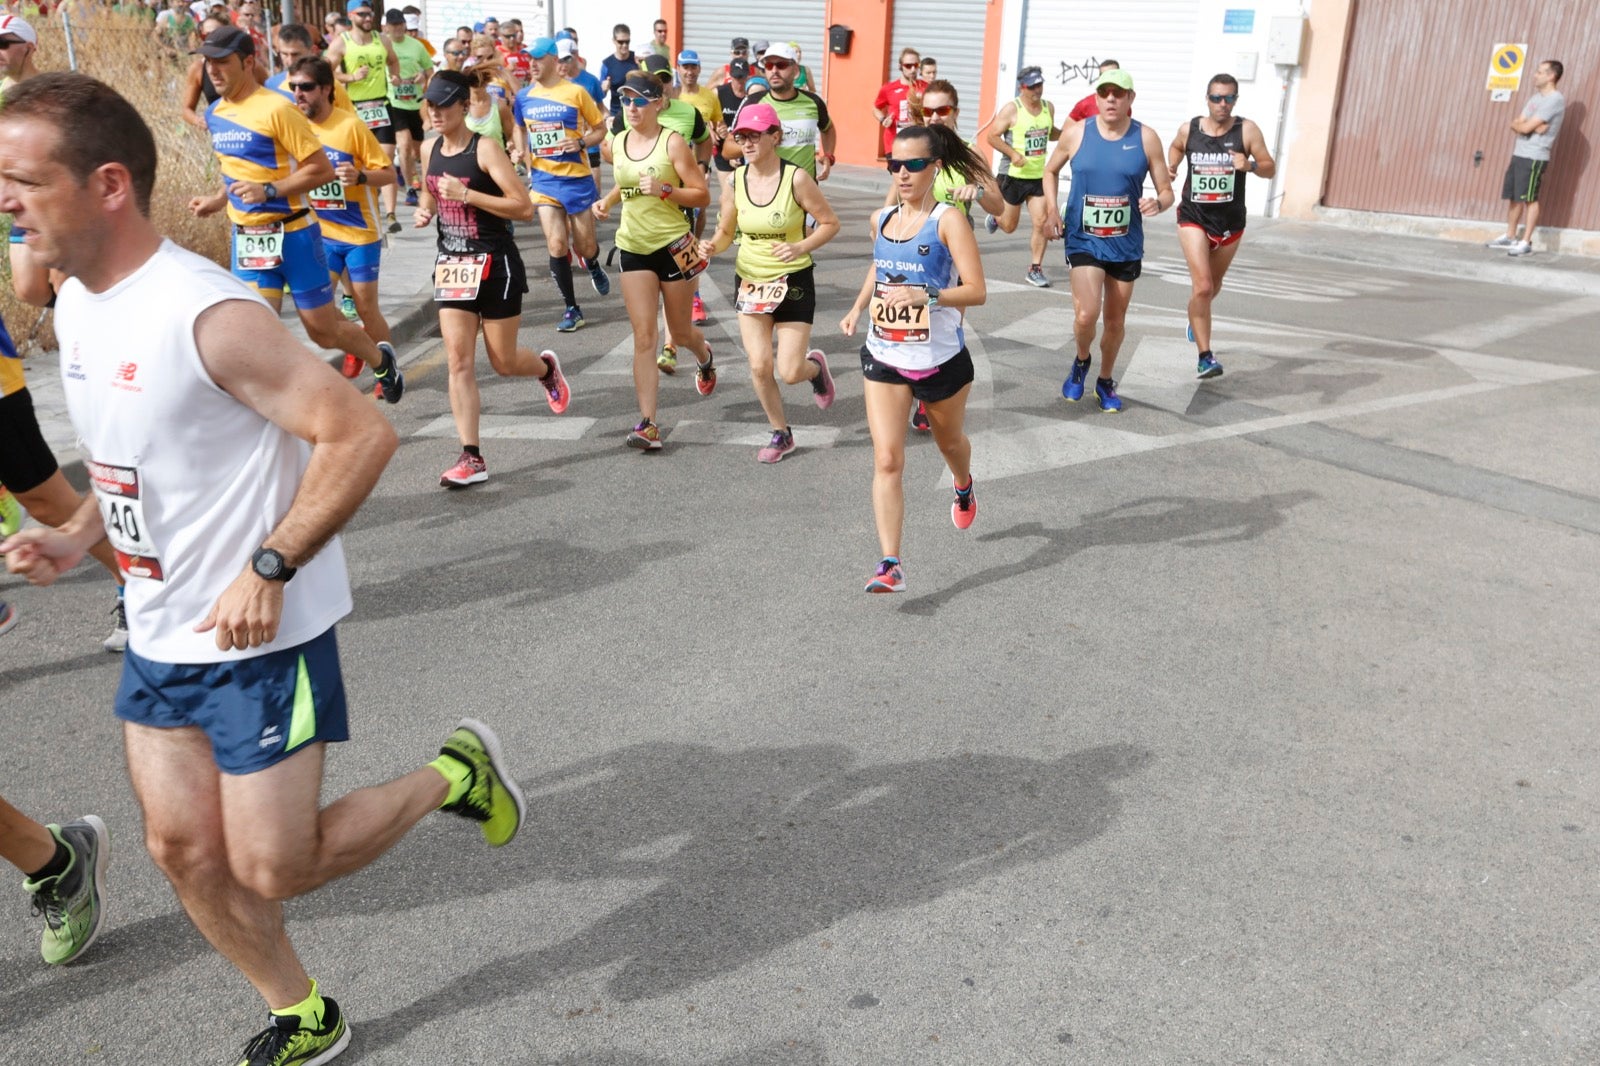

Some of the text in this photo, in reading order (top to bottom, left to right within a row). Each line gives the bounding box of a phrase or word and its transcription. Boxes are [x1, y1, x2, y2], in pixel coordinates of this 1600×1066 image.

[362, 108, 383, 121] 230
[536, 132, 558, 146] 831
[1198, 177, 1228, 190] 506
[1092, 208, 1124, 225] 170
[681, 244, 700, 267] 21
[874, 258, 926, 273] ODO SUMA
[442, 267, 478, 284] 2161
[876, 303, 925, 324] 2047
